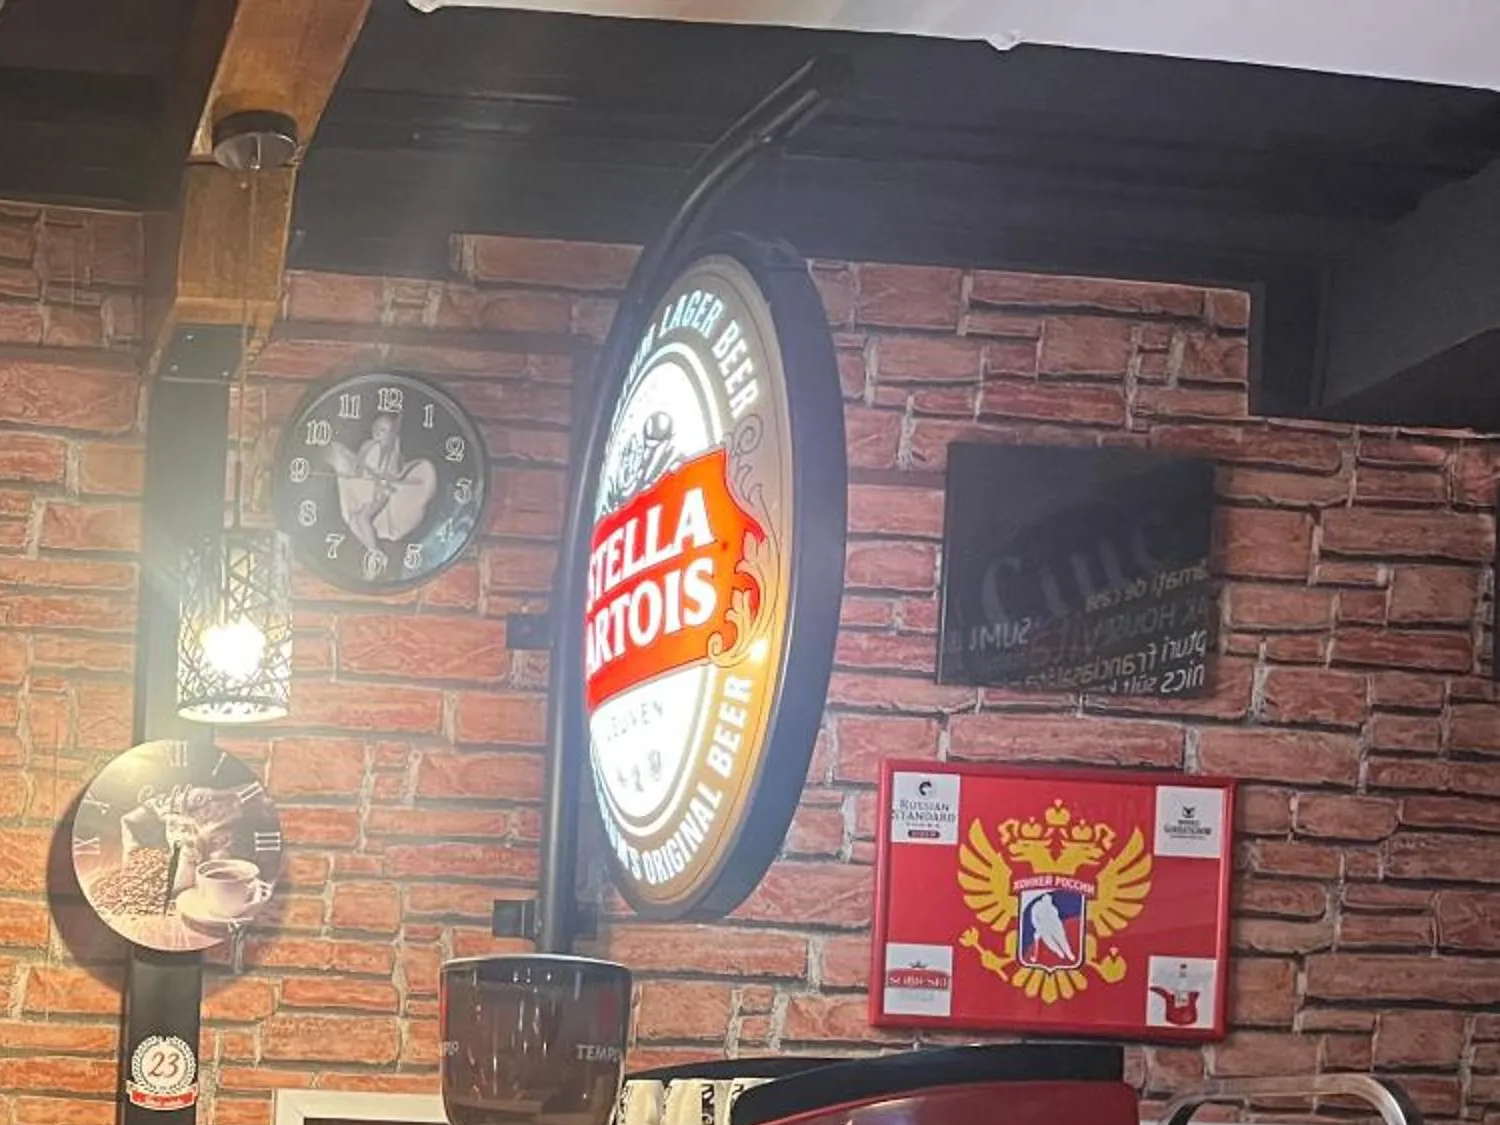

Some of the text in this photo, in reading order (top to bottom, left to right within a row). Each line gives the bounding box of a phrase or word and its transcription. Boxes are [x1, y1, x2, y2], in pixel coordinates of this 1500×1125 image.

[659, 290, 759, 420] LAGER BEER
[338, 393, 362, 419] 11
[377, 387, 403, 412] 12
[422, 403, 434, 428] 1
[305, 419, 332, 446] 10
[445, 435, 465, 462] 2
[289, 457, 310, 483] 9
[297, 499, 317, 527] 8
[325, 532, 345, 559] 7
[403, 543, 422, 569] 5
[587, 487, 715, 616] STELLA
[586, 556, 717, 680] ARTOIS
[640, 675, 755, 885] ORIGINAL BEER
[148, 1051, 181, 1078] 23
[576, 1044, 622, 1064] TEMP
